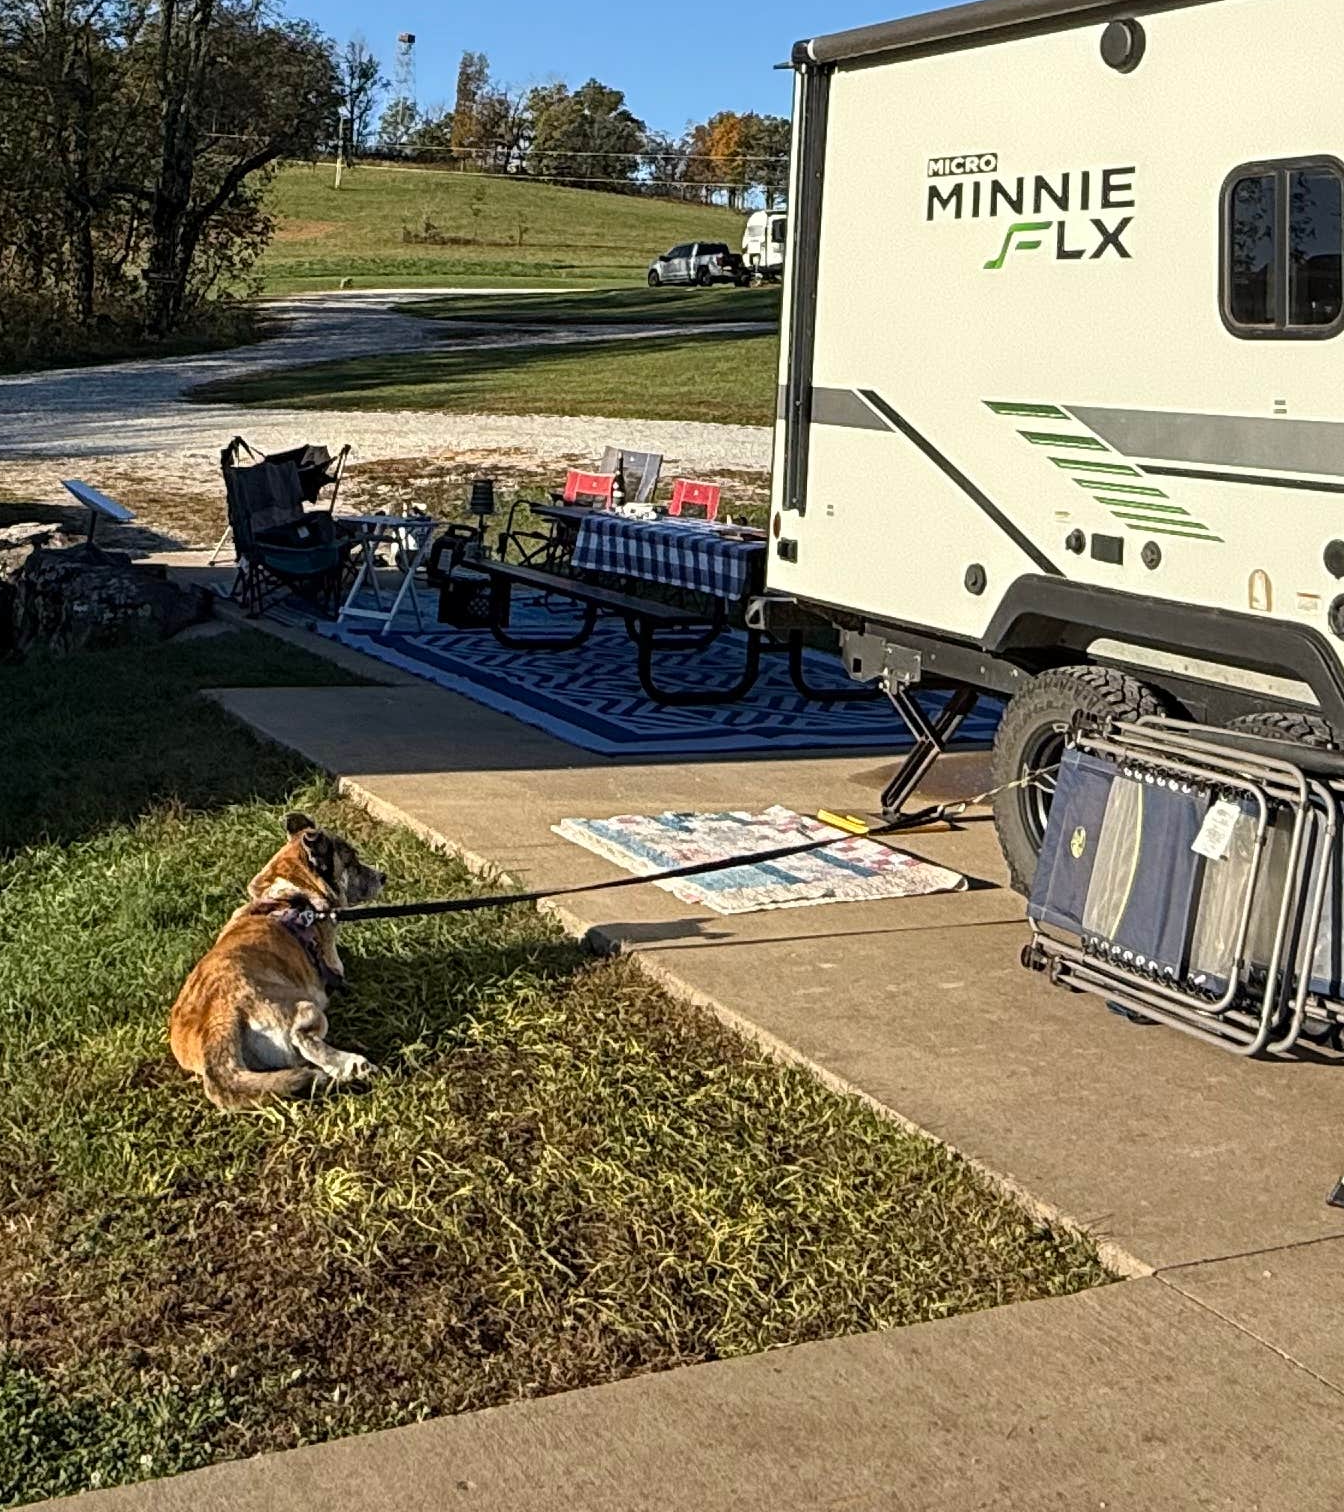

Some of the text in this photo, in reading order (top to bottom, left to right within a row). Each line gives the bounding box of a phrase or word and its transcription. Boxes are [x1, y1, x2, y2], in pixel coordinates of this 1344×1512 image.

[929, 155, 997, 176] MICRO
[927, 166, 1136, 221] MINNIE
[983, 216, 1135, 269] FLX
